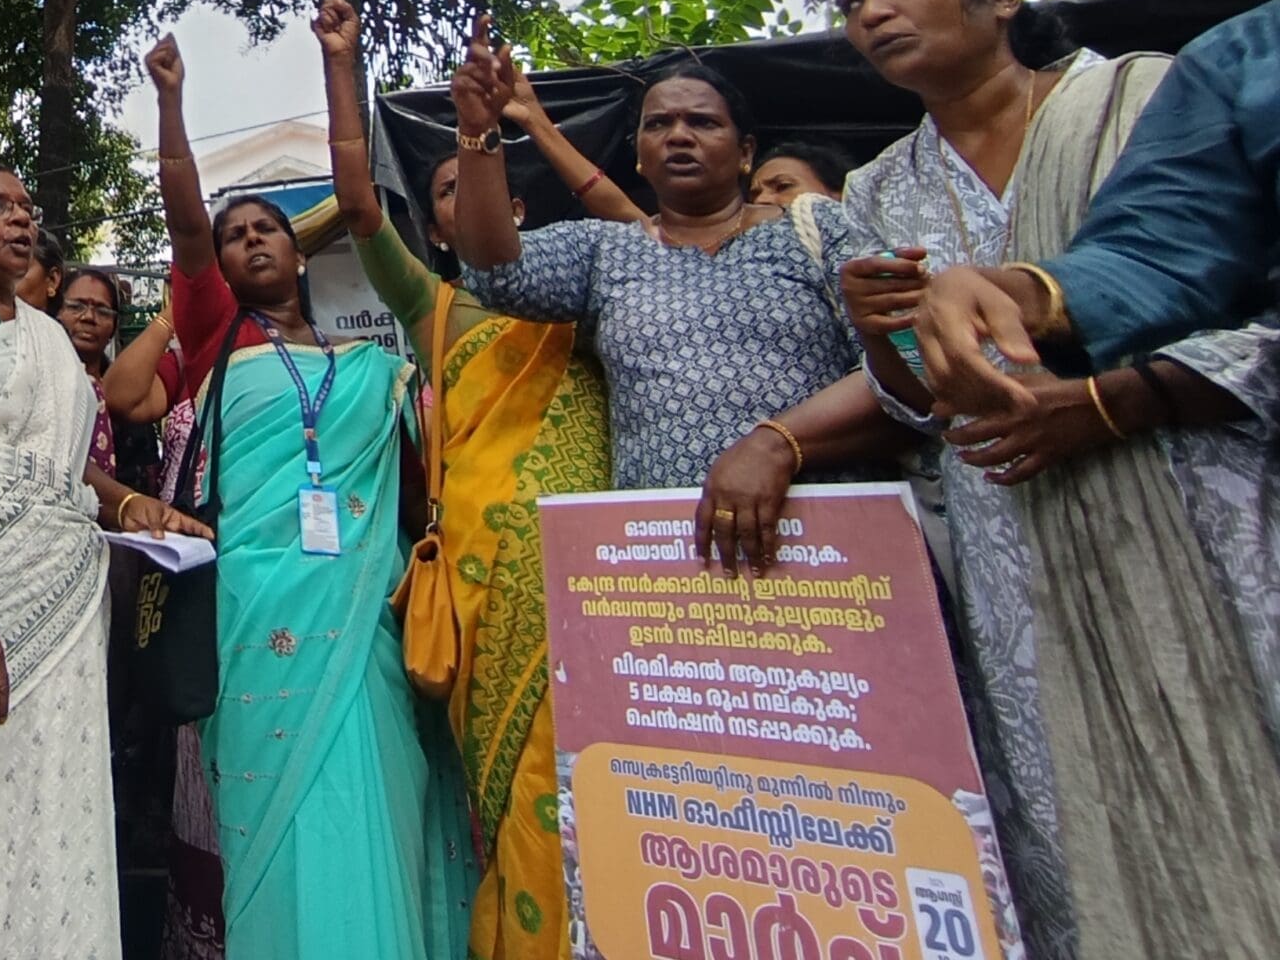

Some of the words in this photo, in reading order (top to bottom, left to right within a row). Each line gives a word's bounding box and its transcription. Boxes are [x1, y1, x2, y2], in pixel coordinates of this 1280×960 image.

[596, 538, 686, 565] രൂപയായി
[567, 575, 615, 596] കേന്ദ്ര
[629, 623, 673, 647] ഉടൻ
[612, 652, 725, 681] വിരമിക്കൽ
[728, 664, 870, 699] ആനുകൂല്യം
[628, 681, 639, 700] 5
[642, 683, 703, 705] ലക്ഷം
[705, 688, 750, 713] രൂപ
[626, 706, 725, 734] പെൻഷൻ
[728, 716, 872, 752] നടപ്പാക്കുക.
[626, 789, 678, 820] NHM
[757, 774, 833, 801] മുന്നിൽ
[838, 782, 906, 814] നിന്നും
[640, 832, 898, 909] ആശമാരുടെ
[918, 903, 976, 957] 20
